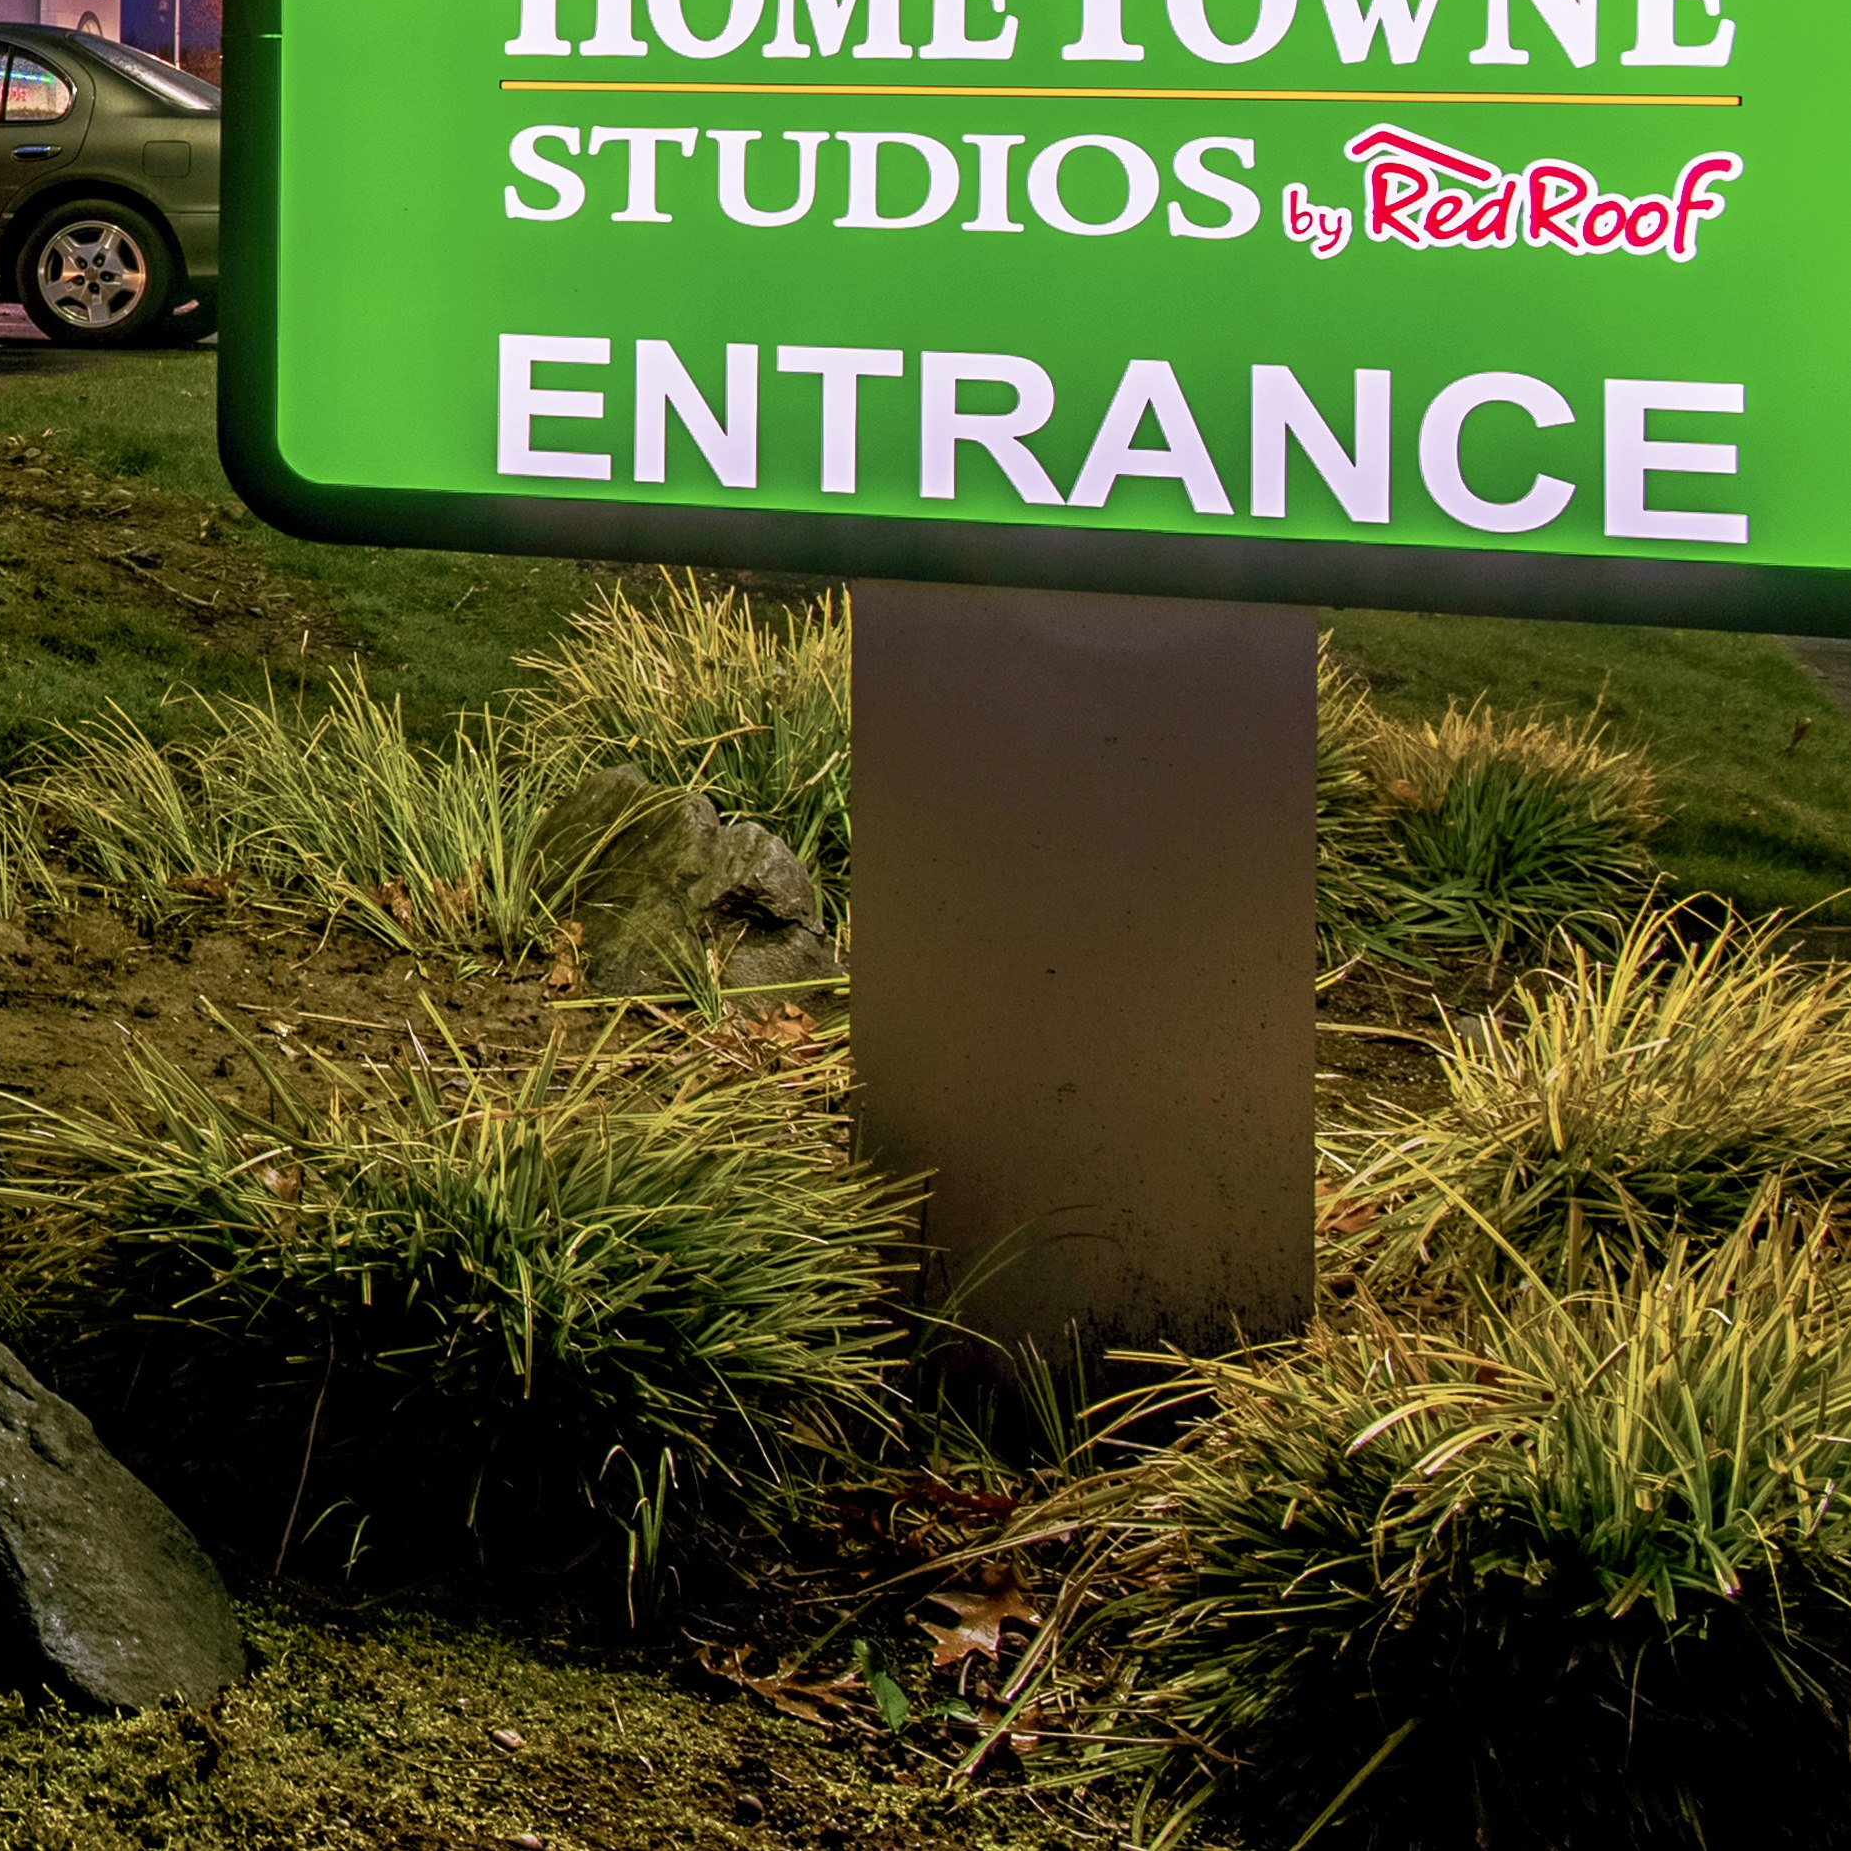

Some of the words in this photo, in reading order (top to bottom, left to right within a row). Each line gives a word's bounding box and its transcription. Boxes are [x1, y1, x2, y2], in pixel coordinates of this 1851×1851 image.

[504, 124, 1261, 238] STUDIOS
[1289, 190, 1343, 253] by
[497, 334, 1749, 544] ENTRANCE
